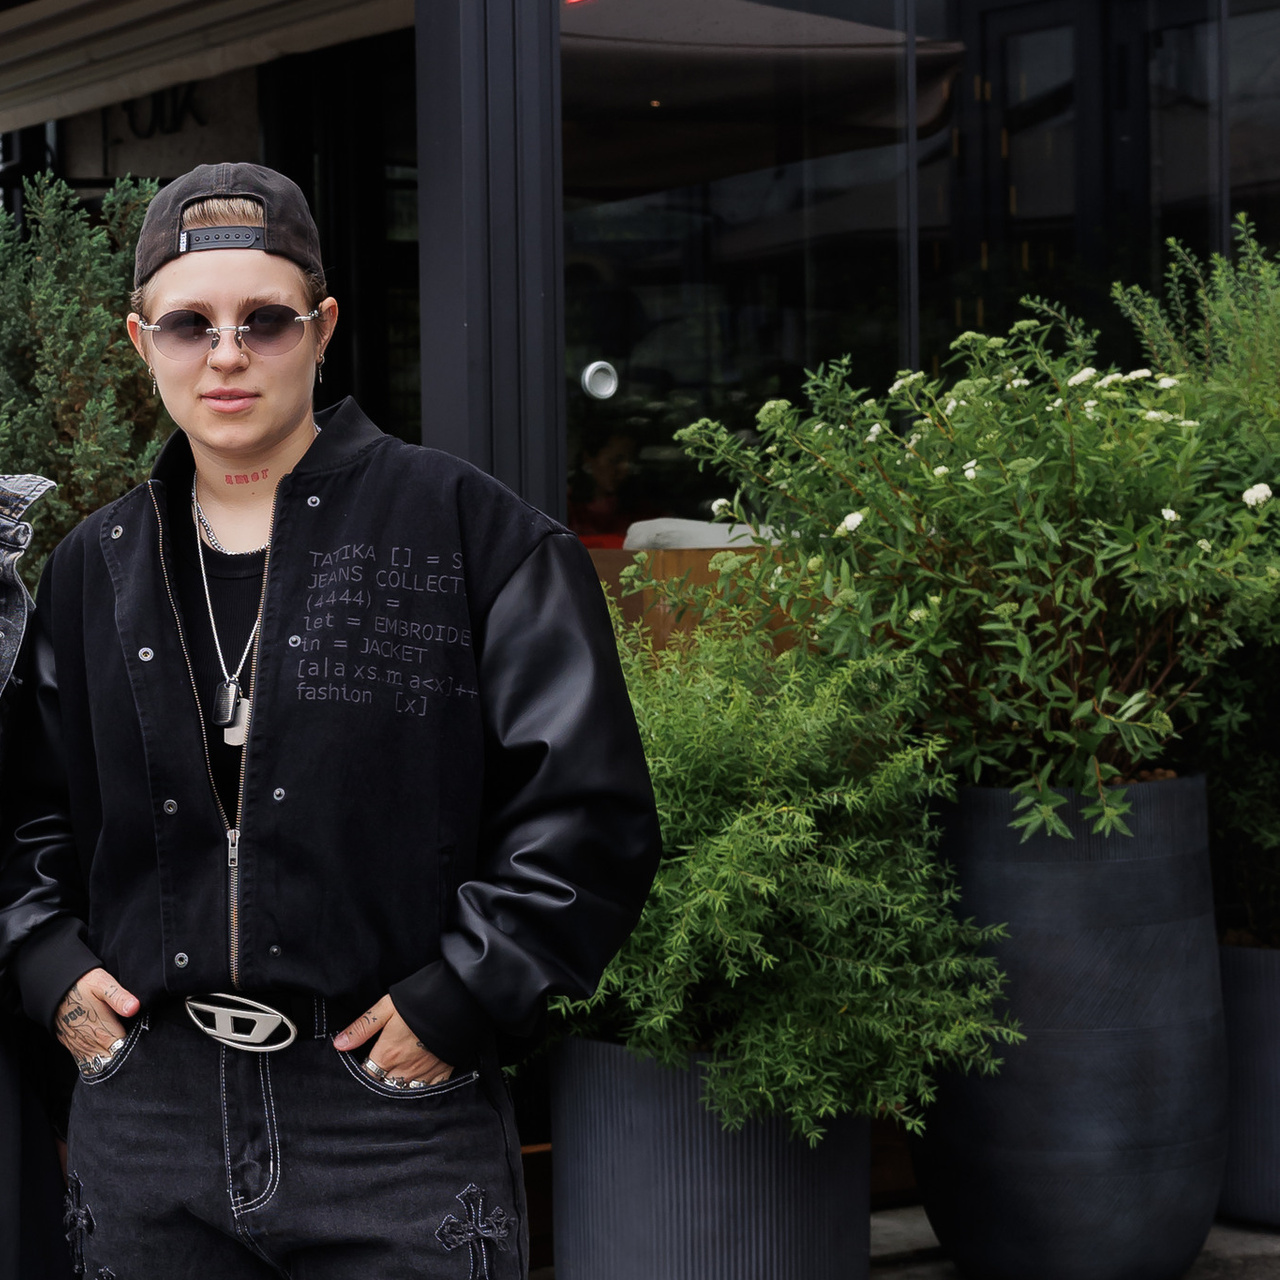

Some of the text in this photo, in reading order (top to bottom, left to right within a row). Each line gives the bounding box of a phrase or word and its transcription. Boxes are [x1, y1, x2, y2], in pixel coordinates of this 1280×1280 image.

[308, 543, 377, 568] TATIKA
[307, 565, 468, 597] JEANS COLLECT
[306, 589, 372, 613] (4444)
[303, 612, 335, 632] let
[374, 616, 471, 647] EMBROIDE
[301, 637, 320, 652] in
[360, 637, 428, 664] JACKET
[296, 681, 428, 718] fashion [x]
